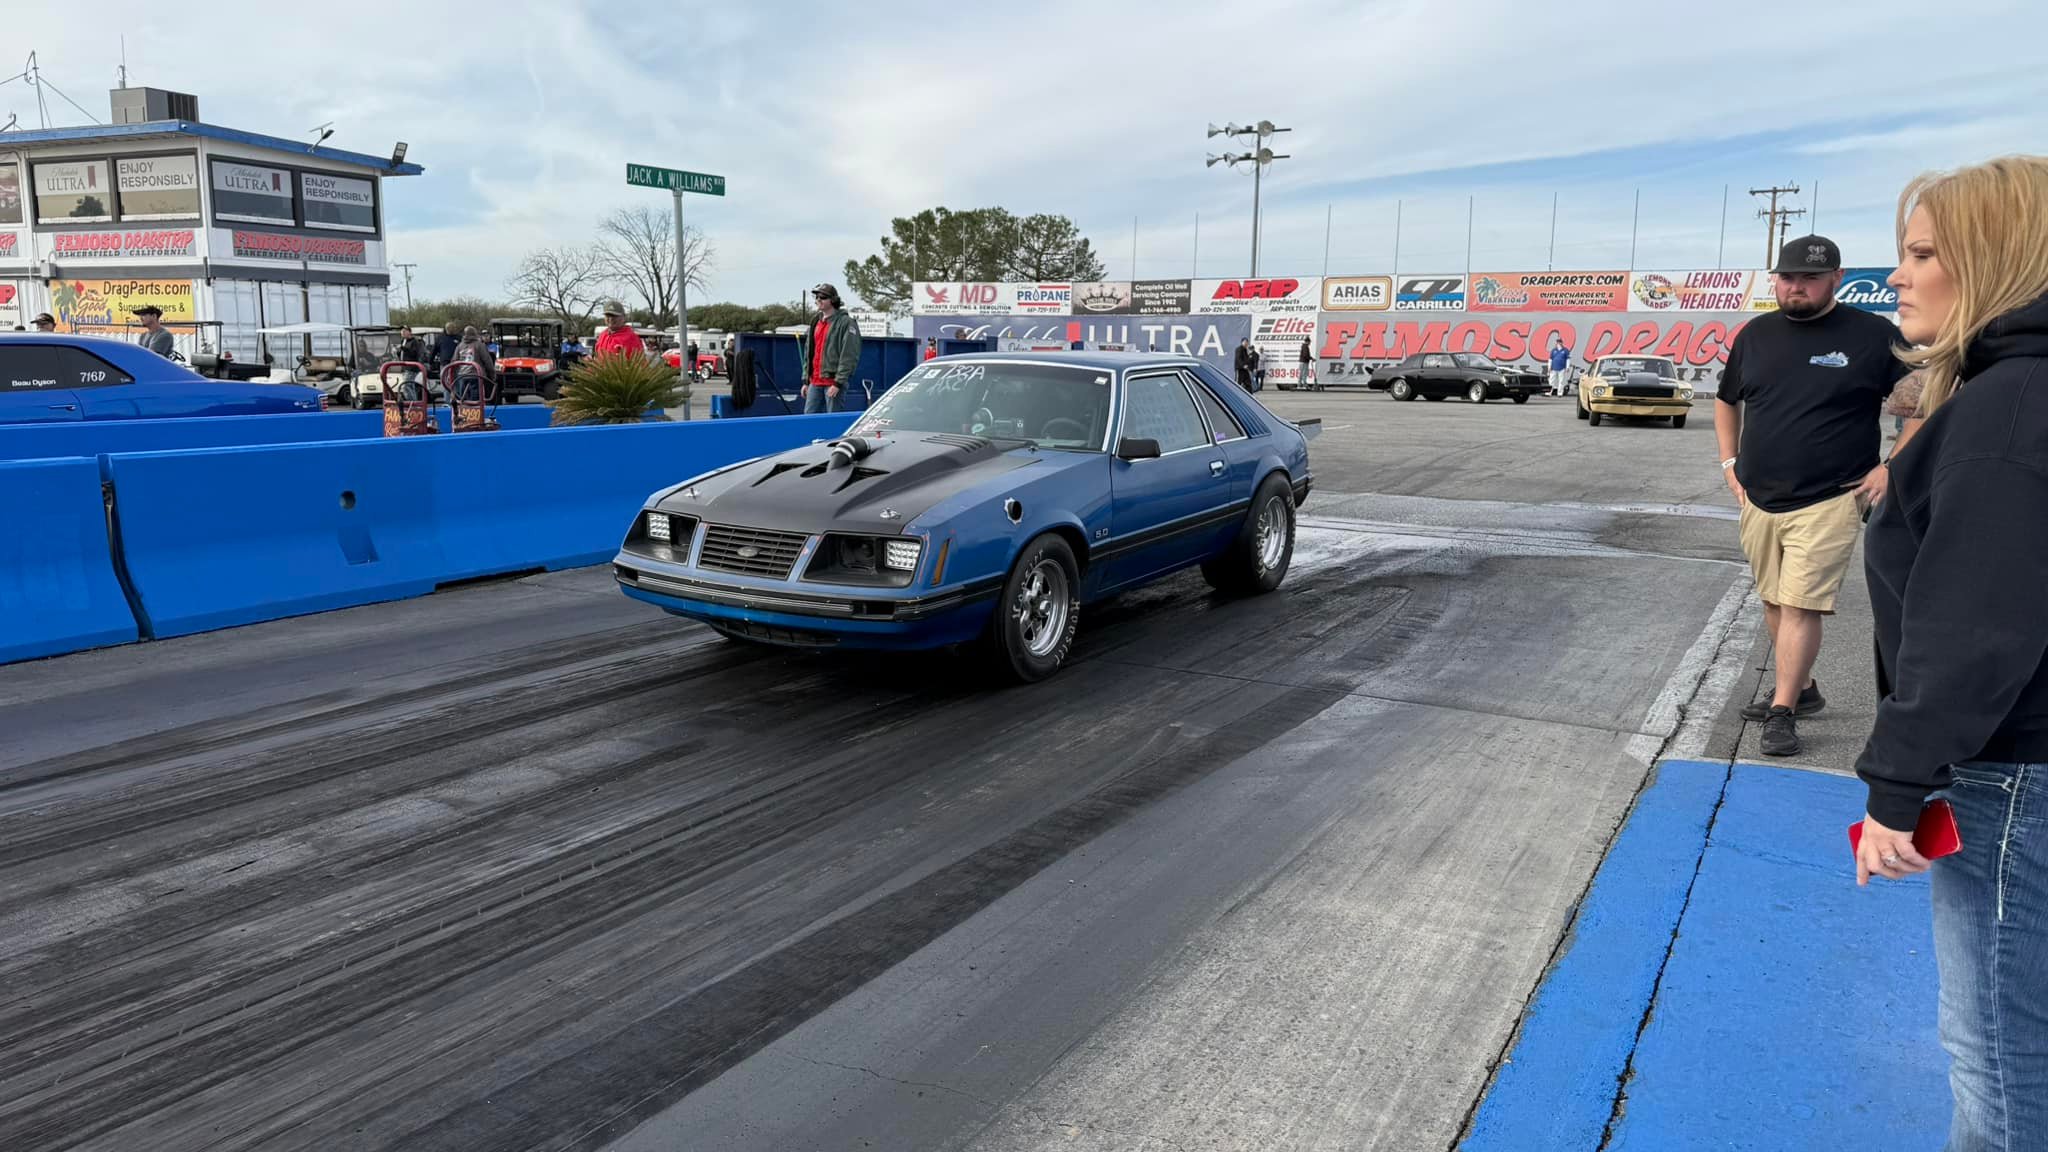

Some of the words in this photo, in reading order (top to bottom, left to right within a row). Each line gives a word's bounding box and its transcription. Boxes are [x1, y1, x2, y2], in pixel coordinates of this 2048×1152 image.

[120, 162, 154, 174] ENJOY
[46, 176, 86, 191] ULTRA
[121, 174, 194, 188] RESPONSIBLY
[225, 175, 269, 191] ULTRA
[305, 177, 336, 188] ENJOY
[628, 166, 652, 184] JACK
[657, 171, 664, 186] A
[668, 172, 713, 192] WILLIAMS
[306, 188, 369, 202] RESPONSIBLY
[55, 233, 122, 251] FAMOSO
[124, 230, 194, 250] DRAGSTRIP
[234, 231, 302, 253] FAMOSO
[129, 249, 187, 257] CALIFORNIA
[1135, 284, 1163, 292] Complete
[1520, 275, 1624, 286] DRAGPARTS.COM
[1684, 272, 1742, 289] LEMONS
[103, 281, 191, 299] DragParts.com
[960, 285, 997, 304] MD
[1212, 279, 1299, 299] ARP
[1333, 285, 1381, 298] ARIAS
[1834, 279, 1896, 304] Linde
[179, 302, 186, 312] &
[1396, 300, 1462, 310] CARRILLO
[1680, 293, 1742, 309] HEADERS
[1272, 317, 1315, 334] Elite
[1319, 320, 1577, 363] FAMOSO
[32, 379, 56, 387] Dyson
